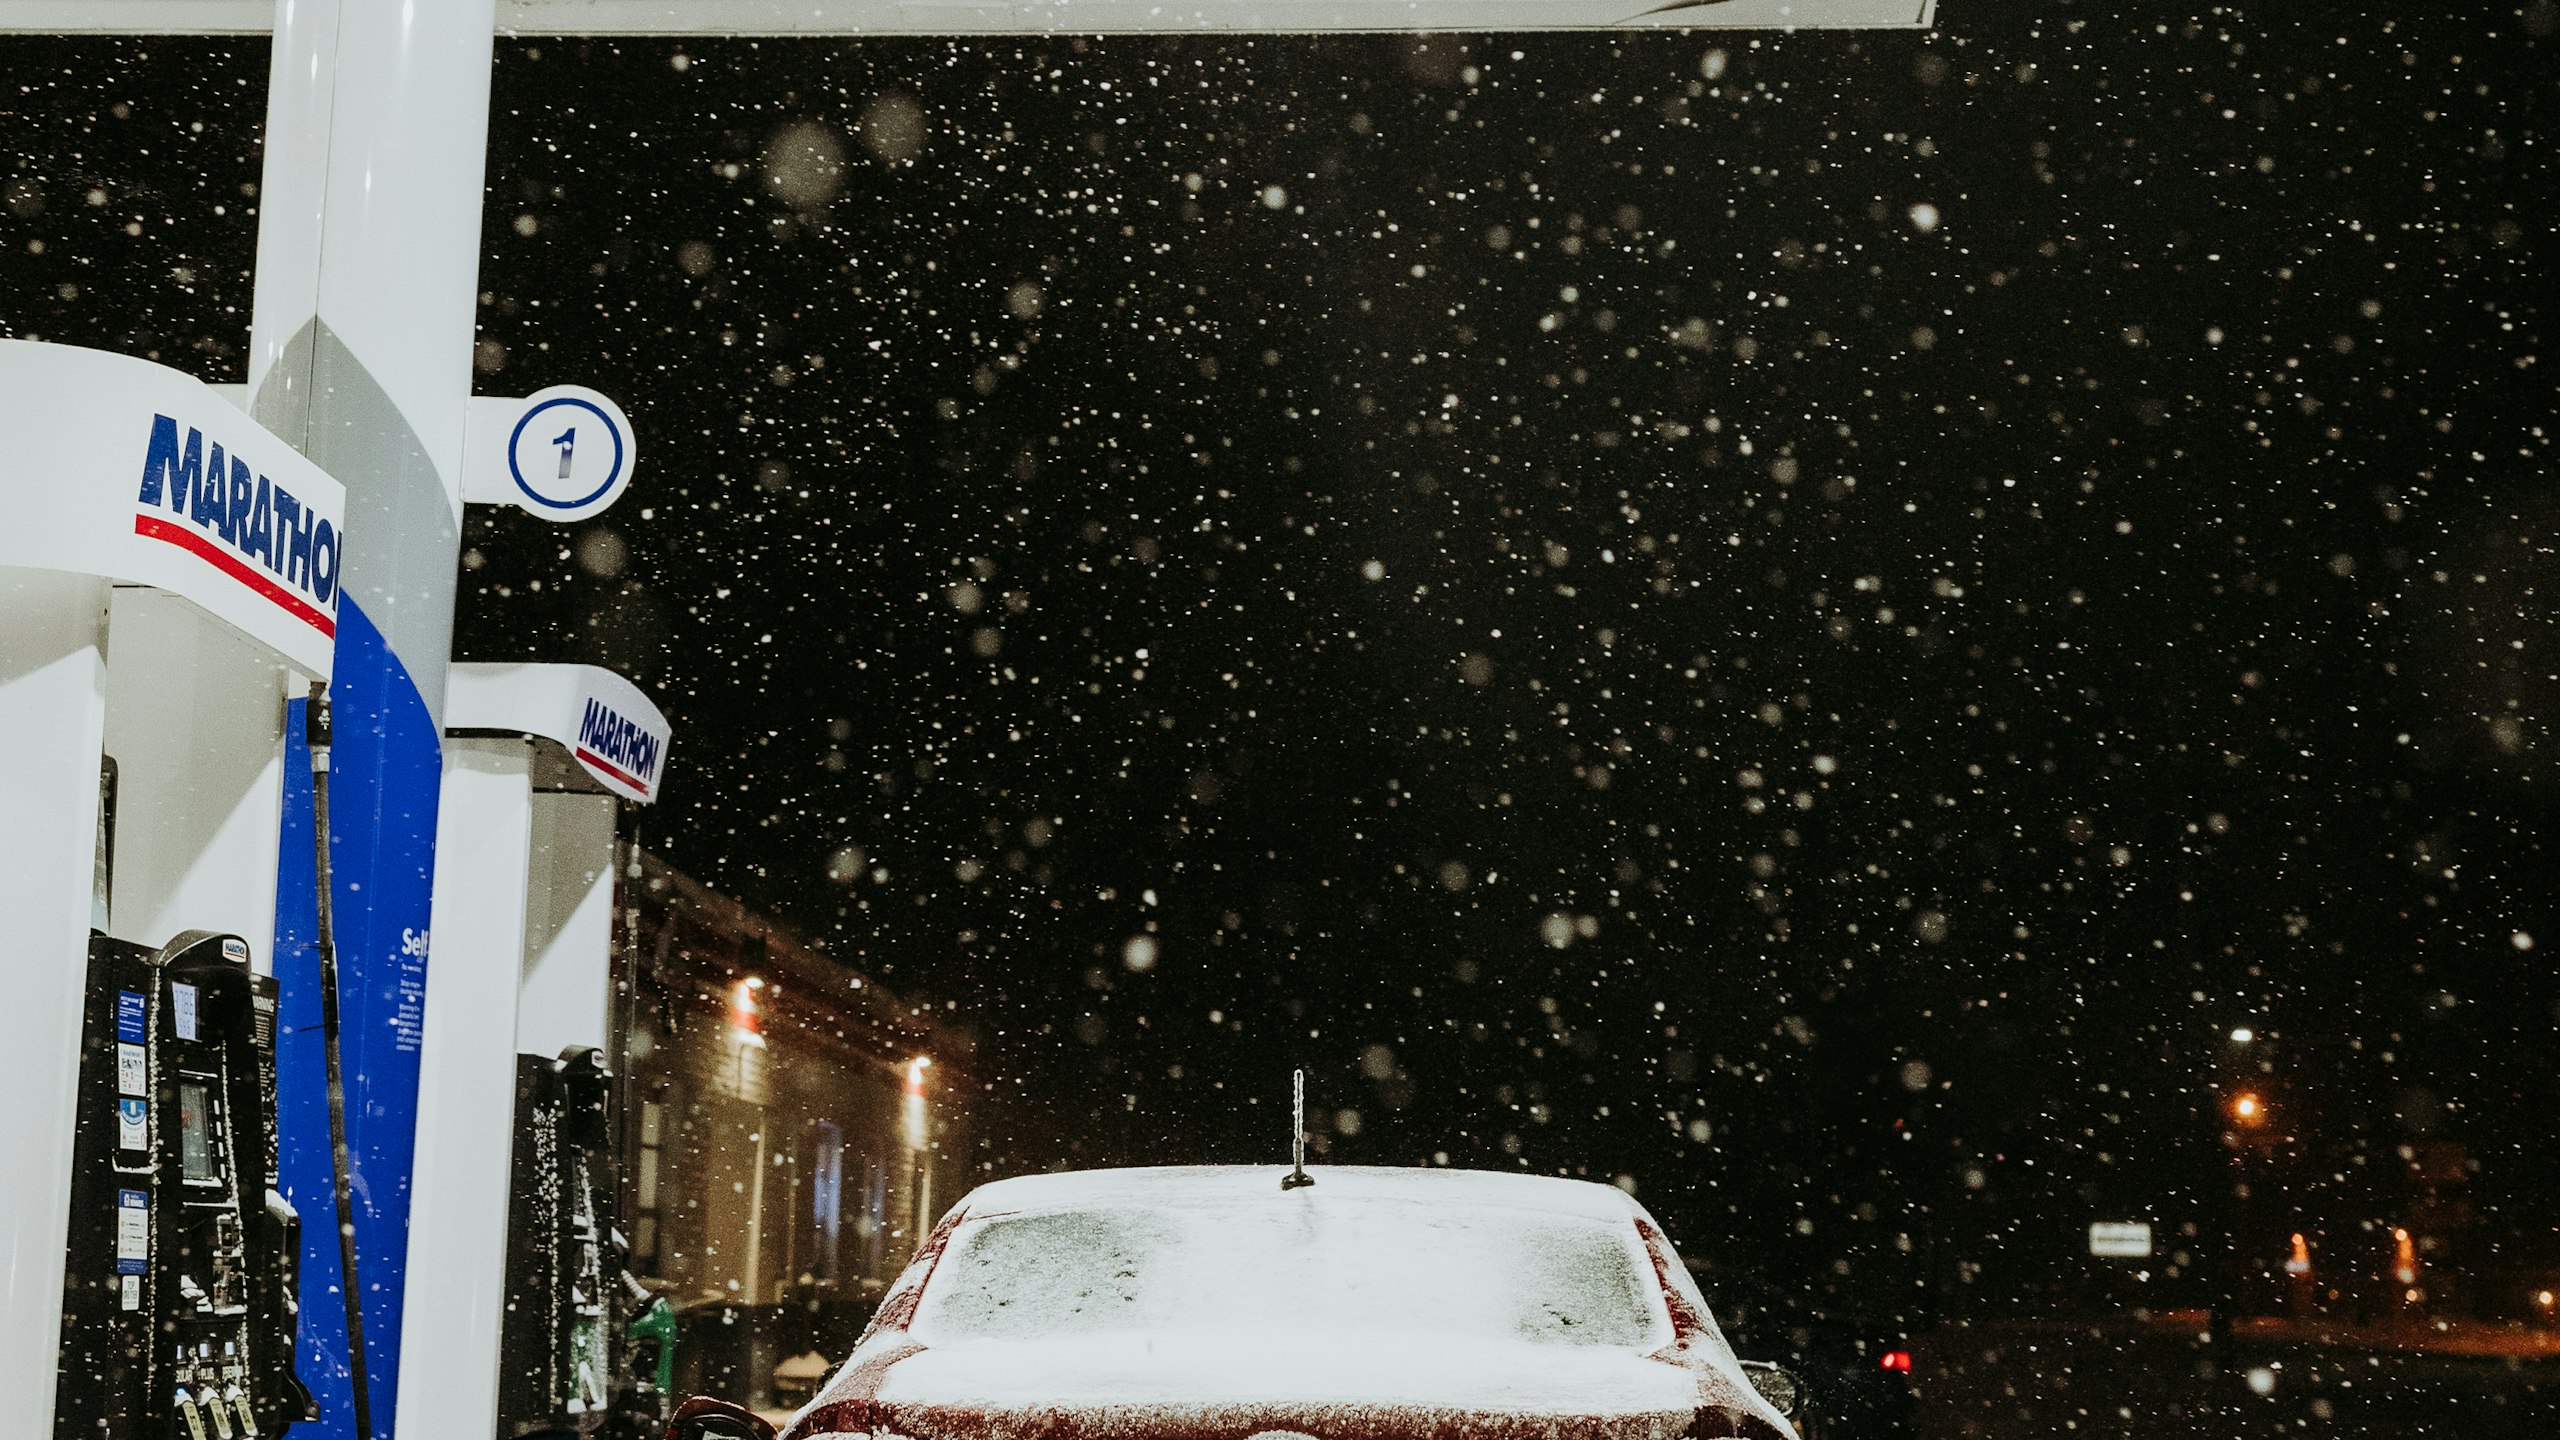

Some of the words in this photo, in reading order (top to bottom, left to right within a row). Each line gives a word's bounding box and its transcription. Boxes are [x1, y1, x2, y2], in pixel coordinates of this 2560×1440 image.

[552, 427, 576, 479] 1
[138, 413, 343, 612] MARATHO
[579, 697, 660, 782] MARATHON
[200, 1367, 214, 1380] PLUS
